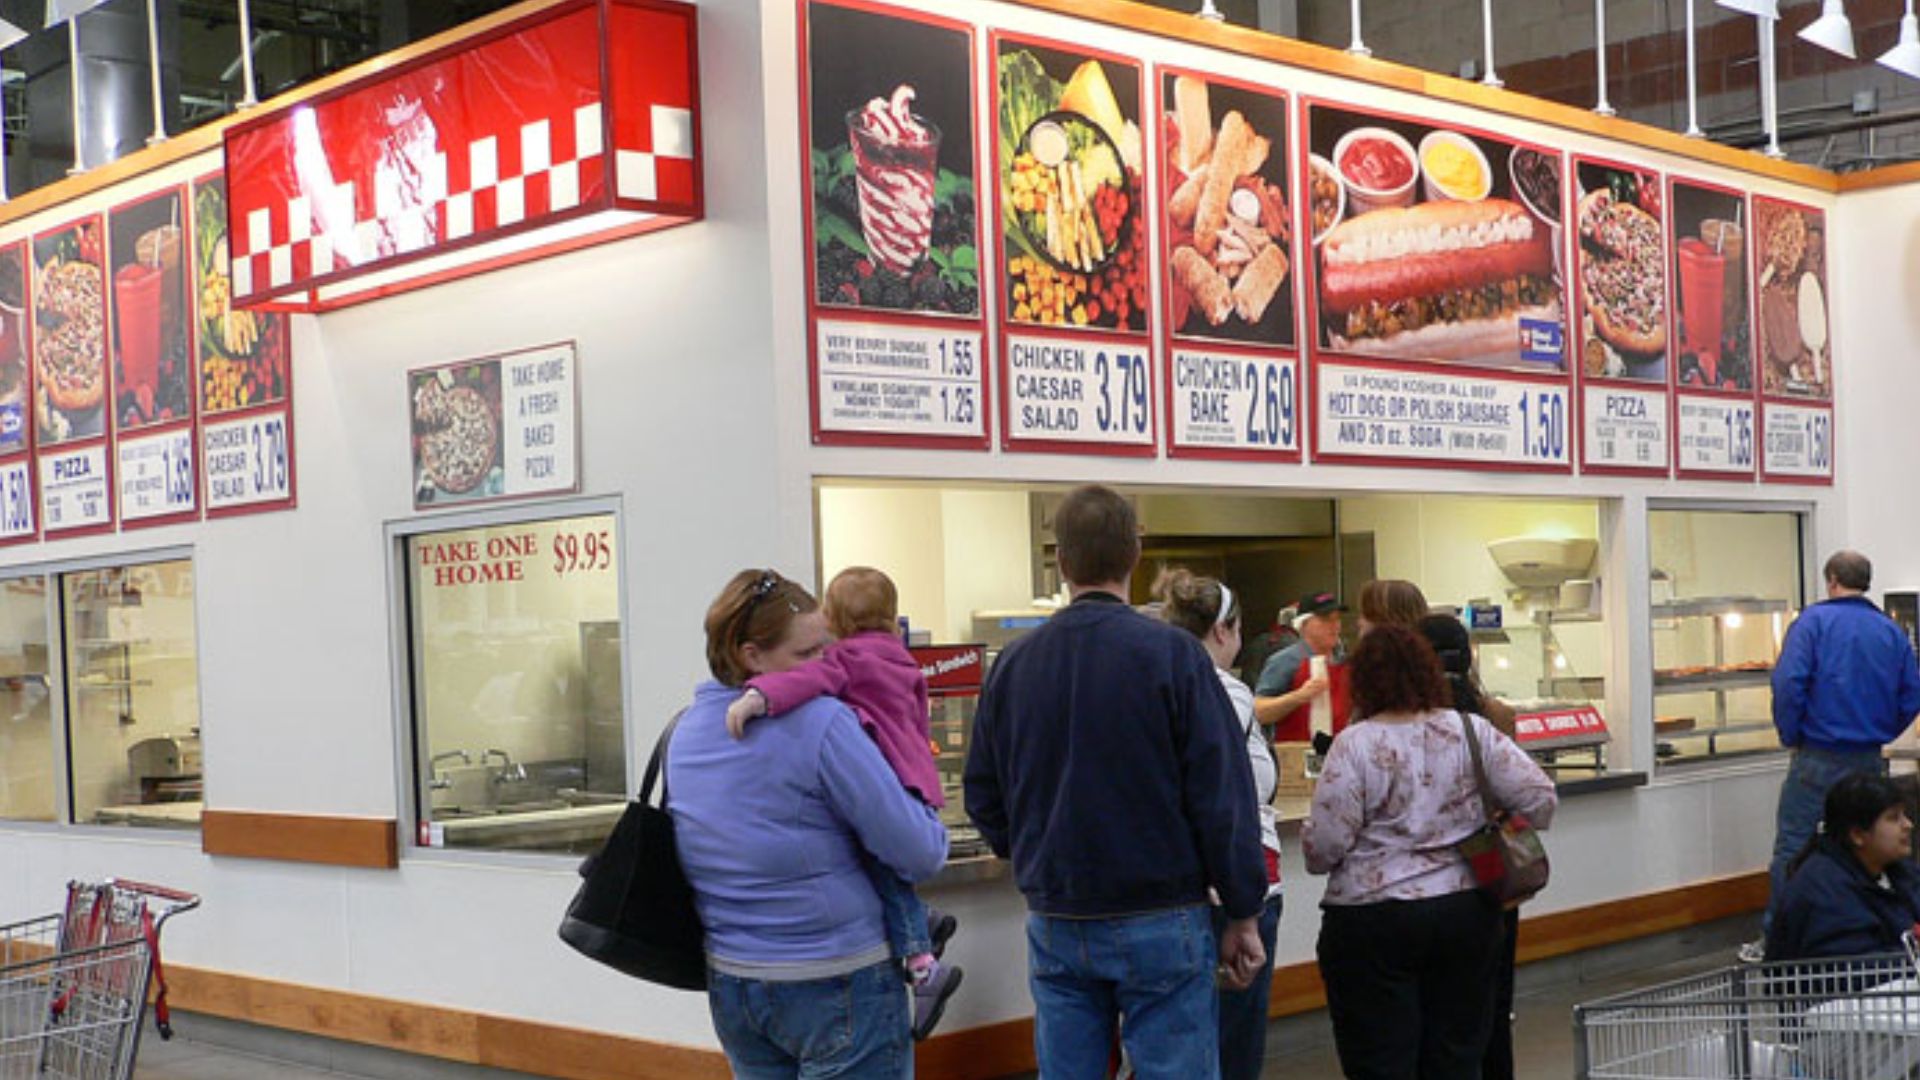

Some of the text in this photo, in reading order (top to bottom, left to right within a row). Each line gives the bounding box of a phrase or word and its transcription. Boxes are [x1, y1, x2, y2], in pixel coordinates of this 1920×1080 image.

[826, 335, 851, 349] VERY
[856, 337, 887, 351] BERRY
[828, 351, 929, 369] WITH STRAWBERRIES
[939, 339, 973, 376] 1.55
[1012, 344, 1085, 372] CHICKEN
[512, 358, 565, 386] TAKE HOME
[1177, 355, 1242, 391] CHICKEN
[1015, 374, 1083, 401] CAESAR
[1095, 351, 1148, 434] 3.79
[1362, 377, 1399, 392] POUND
[1402, 379, 1446, 395] KOSHER
[1450, 383, 1468, 398] ALL
[1471, 385, 1497, 399] BEEF
[529, 391, 558, 414] FRESH
[940, 387, 973, 423] 1.25
[1190, 391, 1229, 423] BAKE
[1246, 363, 1294, 446] 2.69
[1329, 392, 1511, 425] HOT DOG OR POLISH SAUSAGE
[1606, 395, 1647, 418] PIZZA
[1022, 405, 1079, 432] SALAD
[1519, 391, 1563, 459] 1.50
[207, 427, 246, 450] CHICKEN
[524, 423, 554, 448] BAKED
[1339, 422, 1366, 443] AND
[1368, 424, 1385, 444] 20
[1409, 426, 1442, 447] SODA
[54, 455, 91, 480] PIZZA
[209, 451, 247, 475] CAESAR
[212, 477, 244, 499] SALAD
[418, 531, 610, 576] TAKE ONE $9.95
[434, 560, 524, 586] HOME
